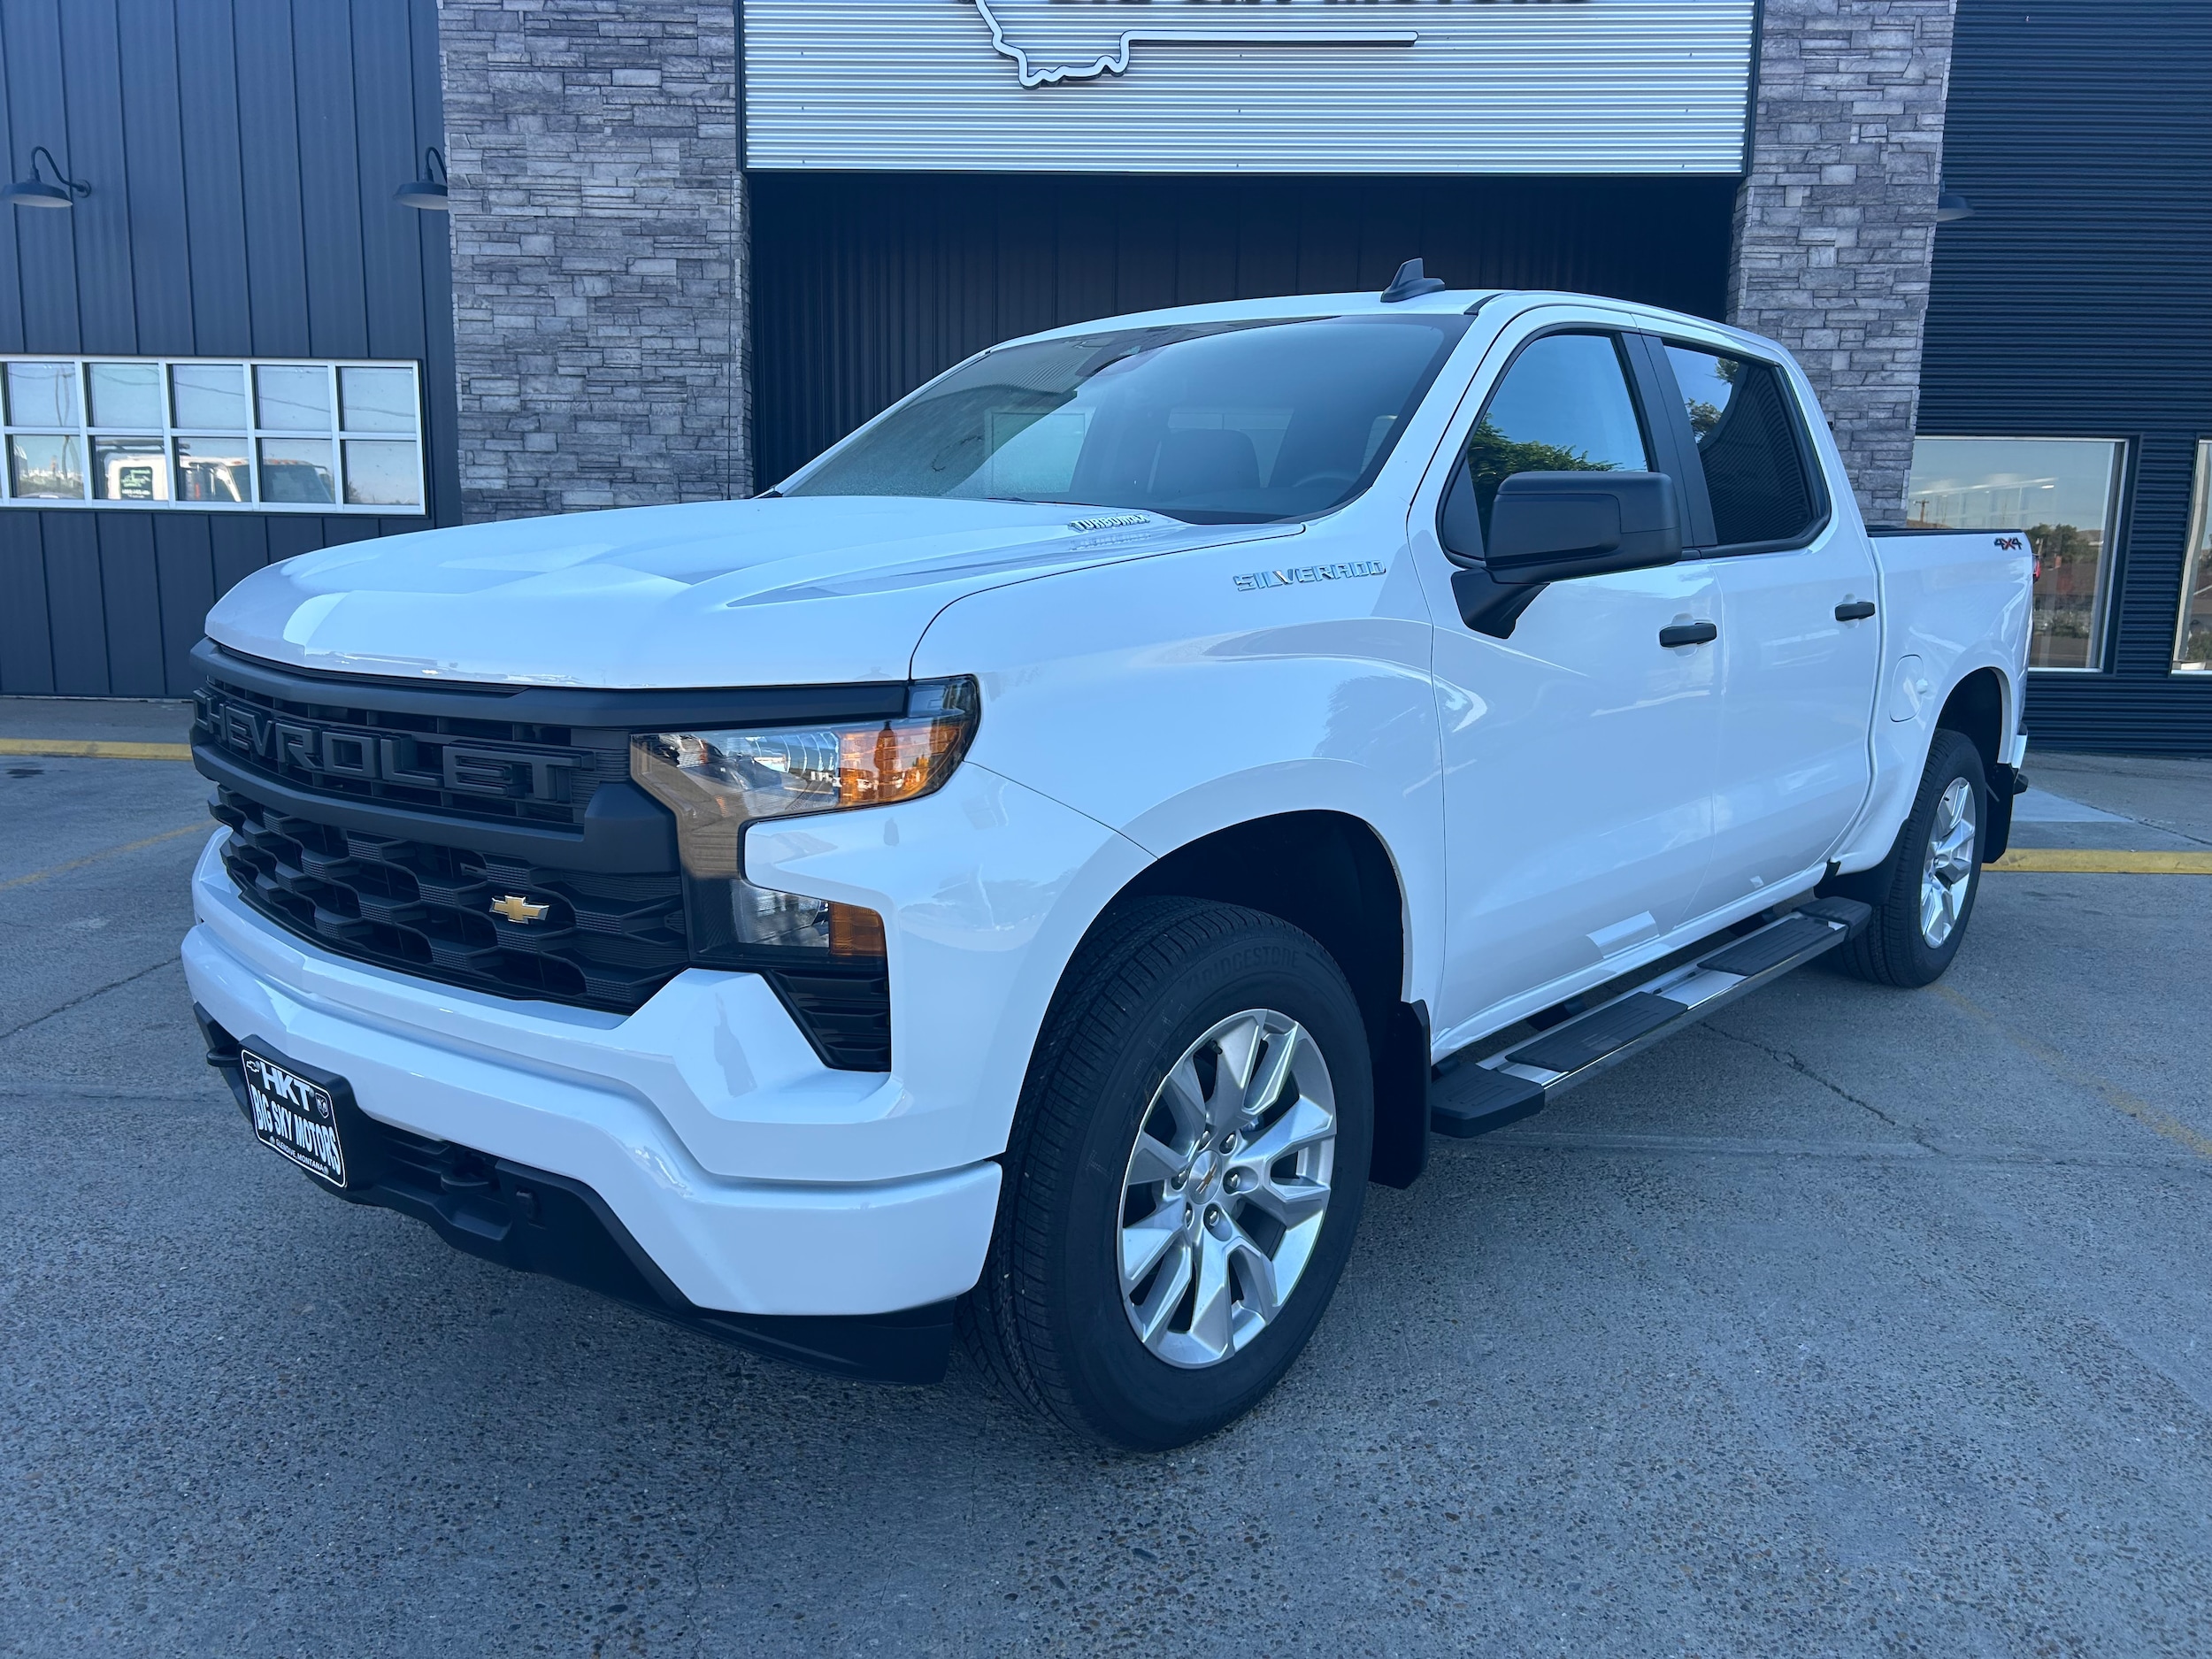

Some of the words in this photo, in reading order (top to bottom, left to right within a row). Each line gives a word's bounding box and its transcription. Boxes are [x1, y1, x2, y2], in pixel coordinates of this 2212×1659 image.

[1068, 513, 1150, 533] TURBOMAX
[1233, 559, 1386, 592] SILVERADO
[192, 685, 596, 802] CHEVROLET
[260, 1061, 311, 1112] HKT
[250, 1084, 273, 1133] BIG
[271, 1100, 293, 1141] SKY
[294, 1113, 342, 1176] MOTORS
